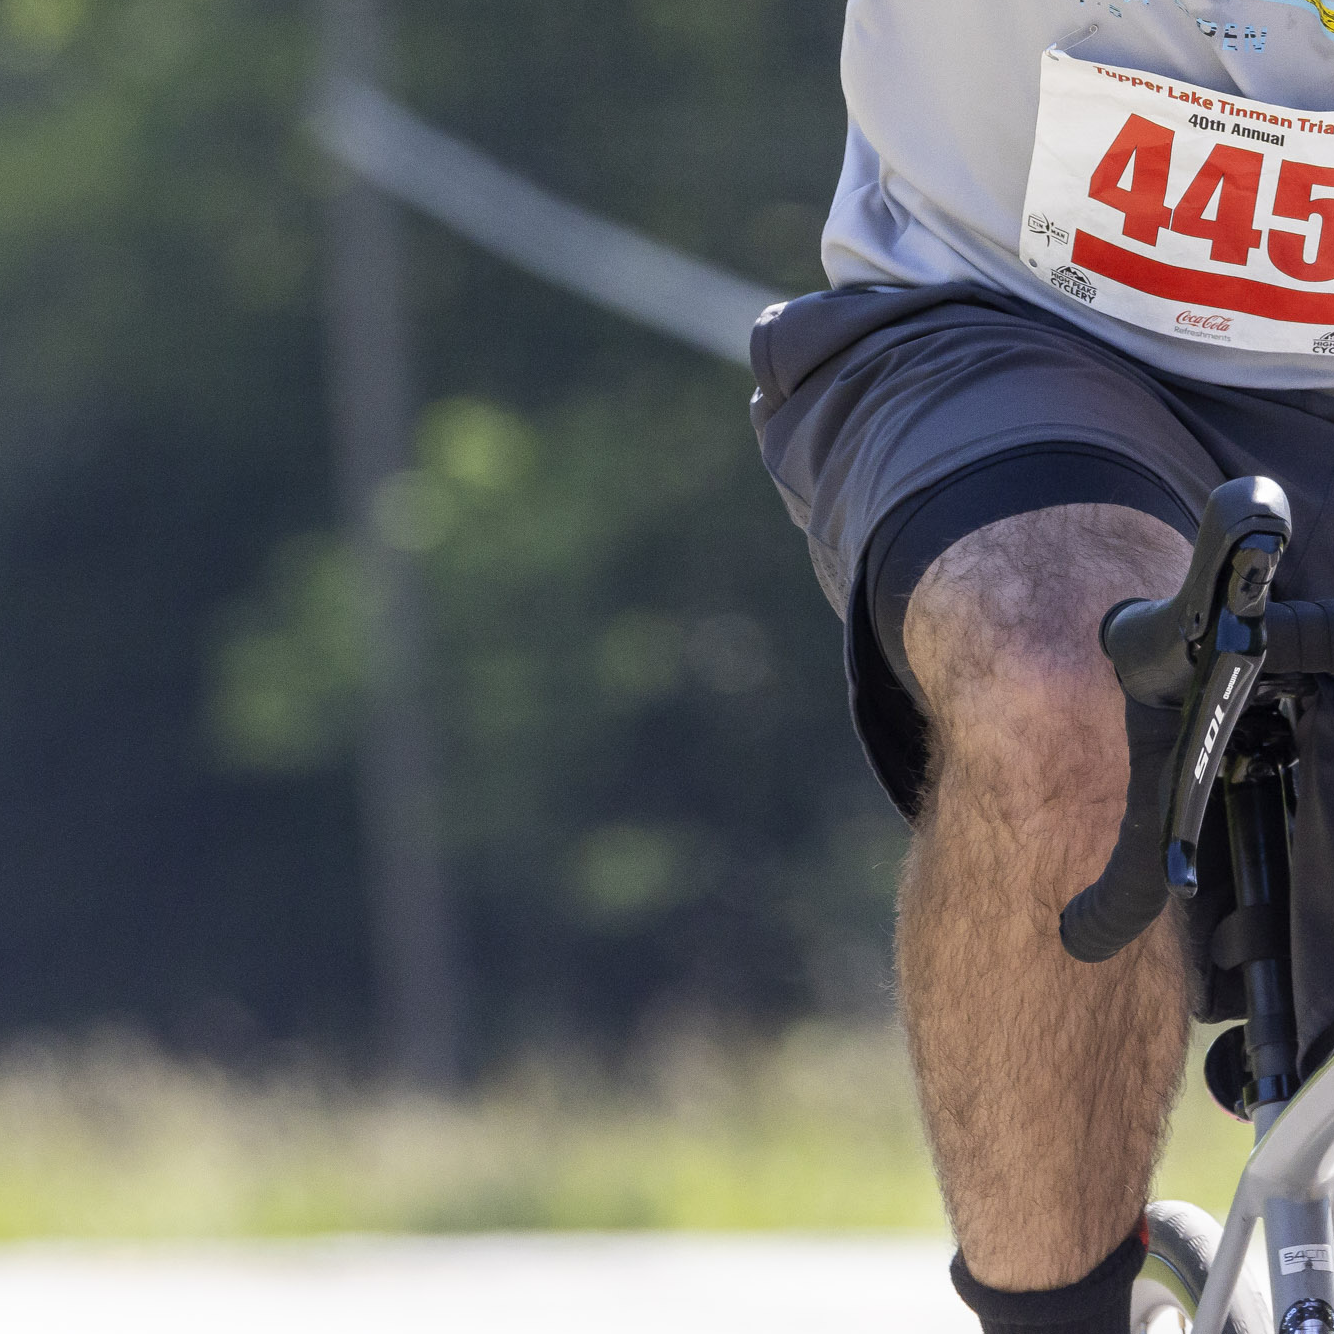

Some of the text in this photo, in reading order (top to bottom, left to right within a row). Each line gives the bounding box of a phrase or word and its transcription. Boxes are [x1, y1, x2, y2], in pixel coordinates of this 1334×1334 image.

[1093, 66, 1163, 93] Tupper
[1168, 86, 1213, 110] Lake
[1218, 99, 1292, 129] Tinman
[1188, 114, 1285, 147] 40th Annual
[1051, 229, 1065, 239] MAN
[1050, 277, 1096, 303] CYCLERY
[1051, 271, 1070, 284] HIGH
[1072, 281, 1097, 296] PEAKS
[1174, 326, 1231, 342] Refreshments
[1194, 667, 1241, 784] SHIMANO 105
